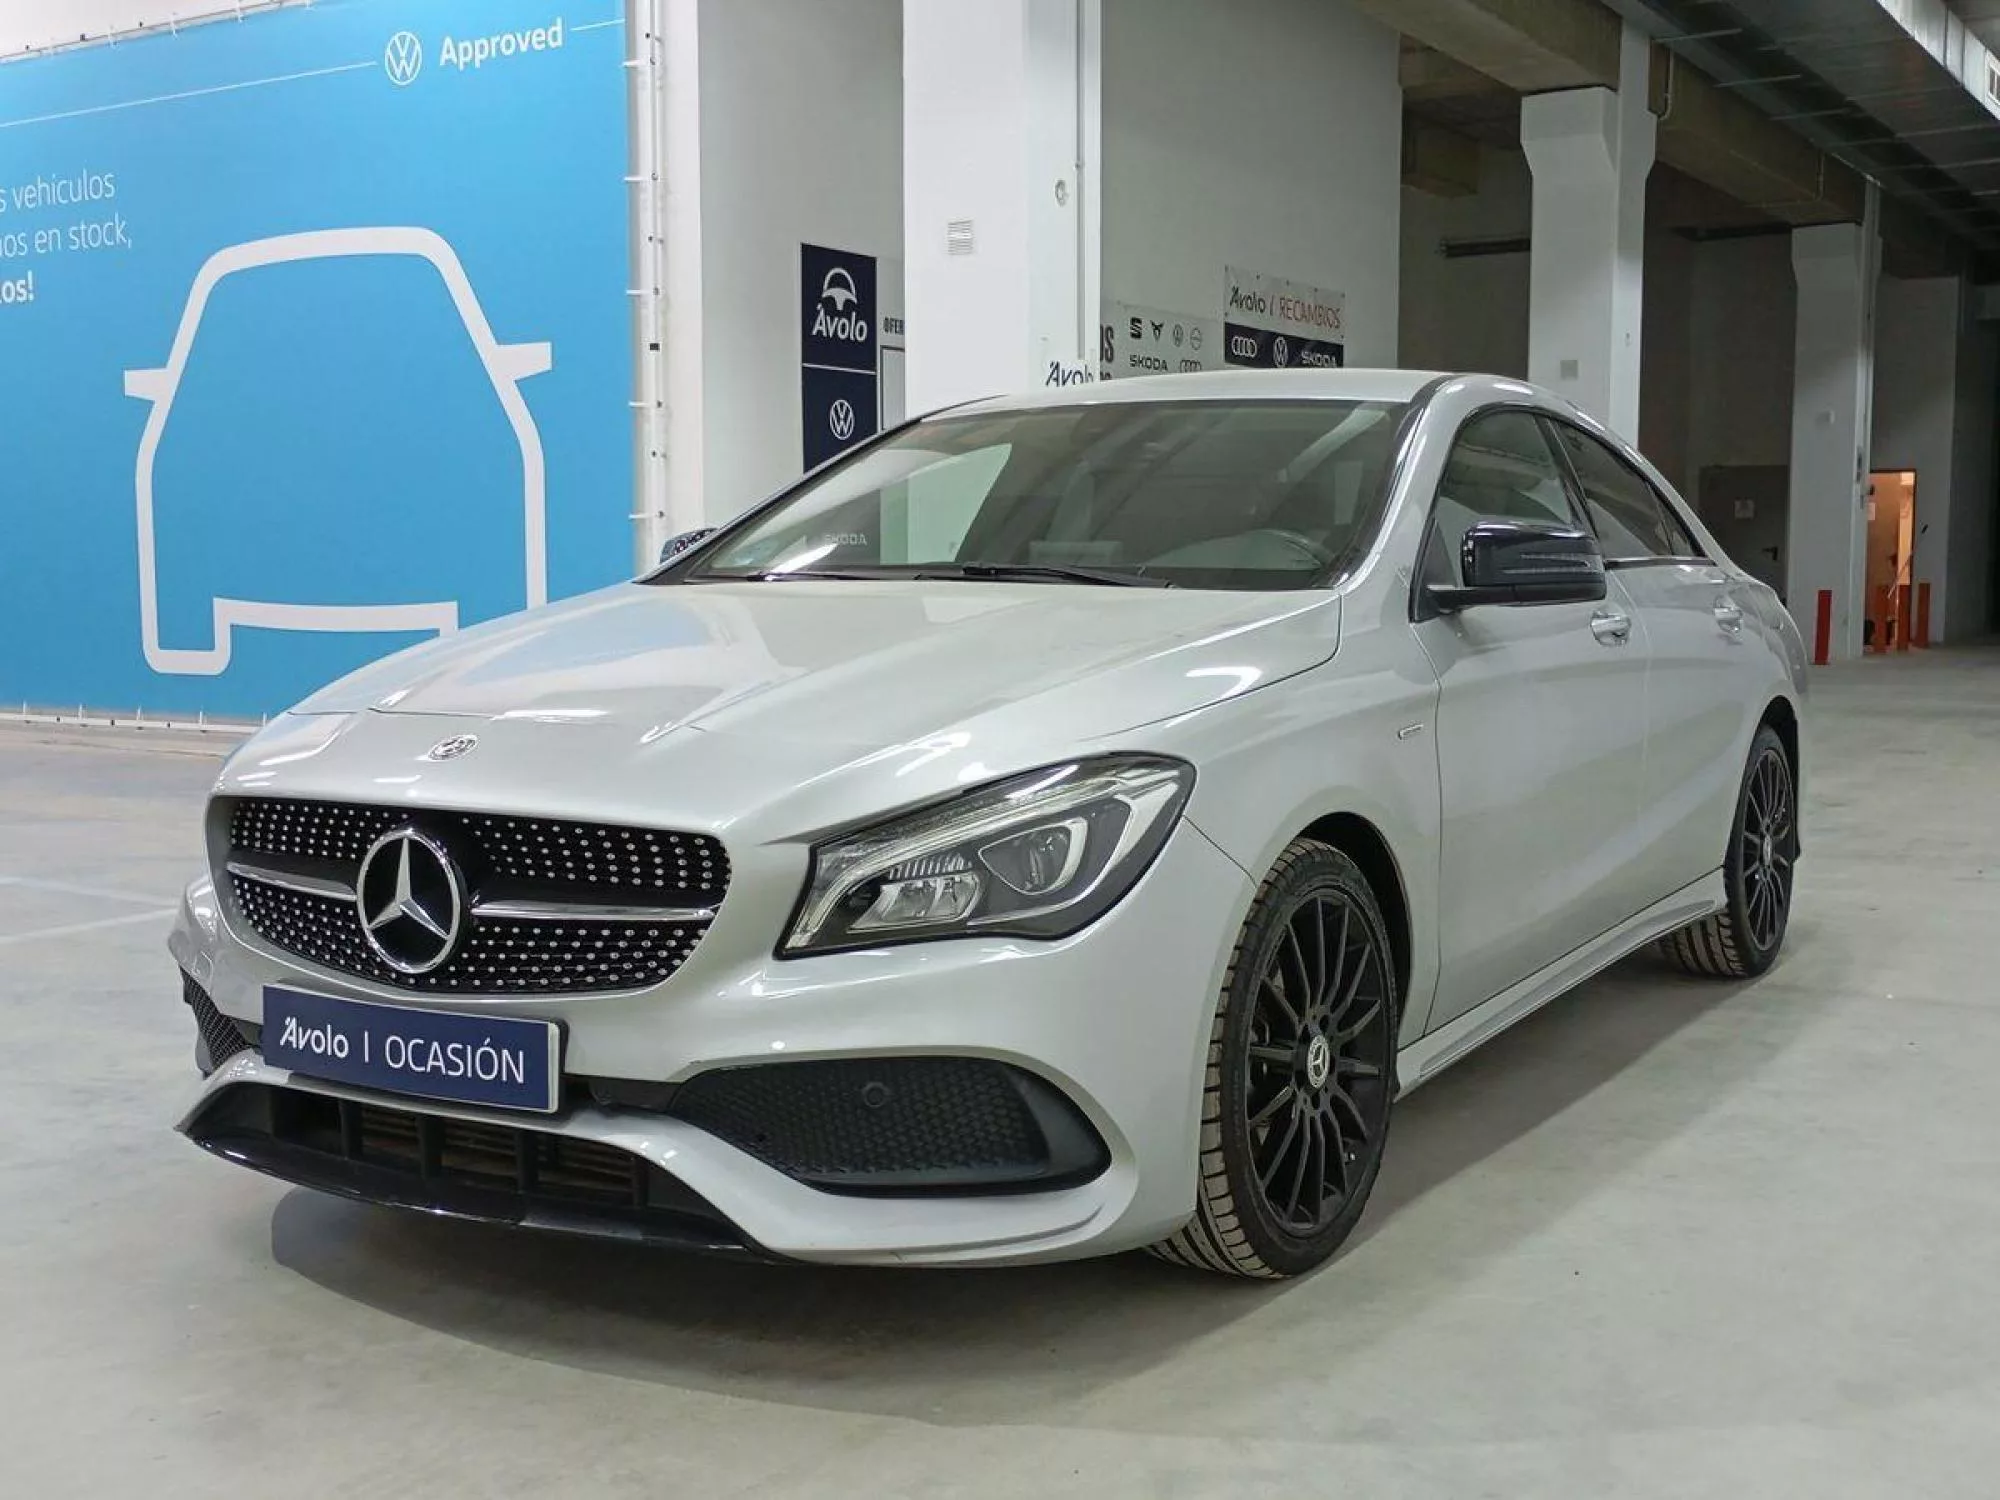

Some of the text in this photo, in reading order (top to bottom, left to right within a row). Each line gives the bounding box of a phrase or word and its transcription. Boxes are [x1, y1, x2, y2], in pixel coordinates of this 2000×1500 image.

[440, 16, 563, 71] Approved
[34, 227, 61, 254] en
[68, 211, 132, 250] stock,
[0, 270, 34, 303] os!
[385, 1036, 525, 1084] OCASIÓN
